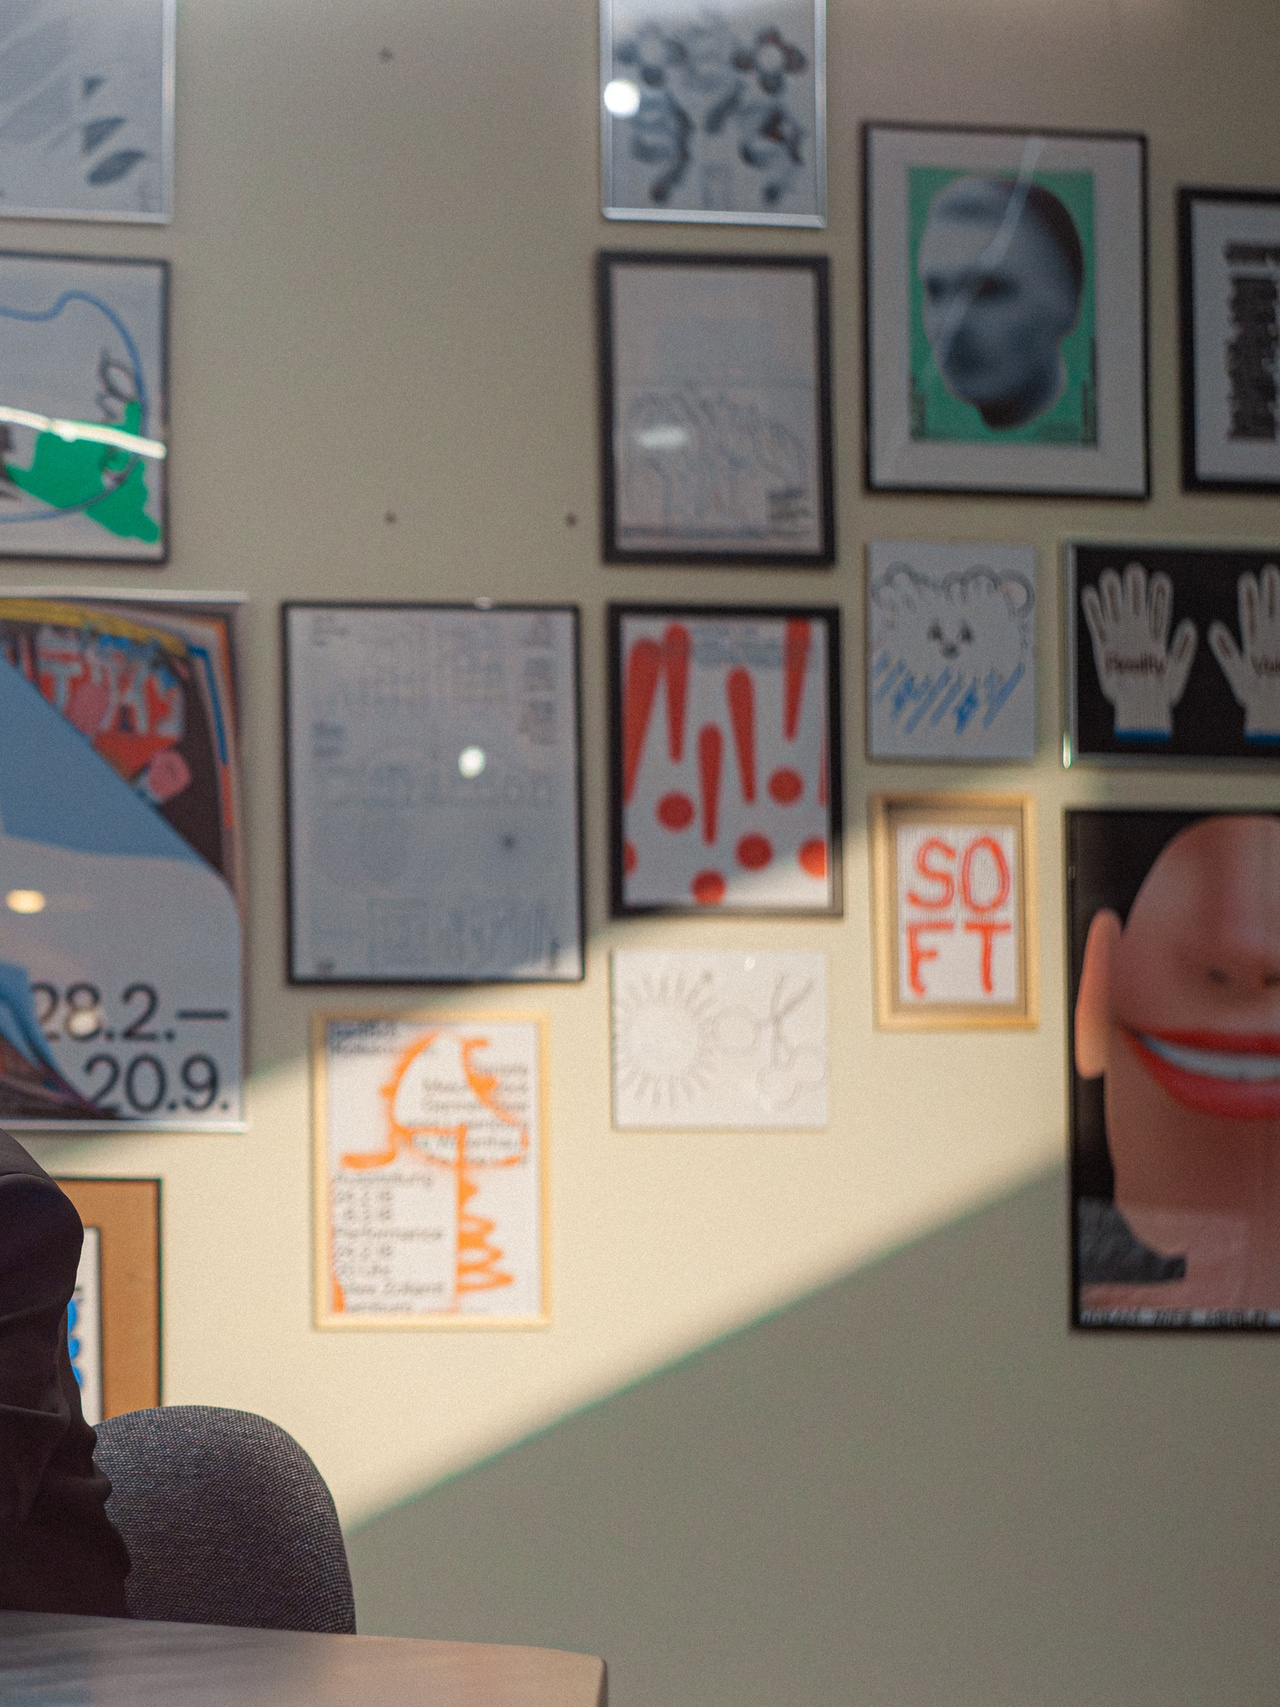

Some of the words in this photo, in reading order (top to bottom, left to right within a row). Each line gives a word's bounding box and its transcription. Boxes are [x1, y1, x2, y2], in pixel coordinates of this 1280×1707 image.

[906, 835, 1011, 911] SO
[907, 920, 1012, 997] FT
[84, 1052, 229, 1113] 20.9.
